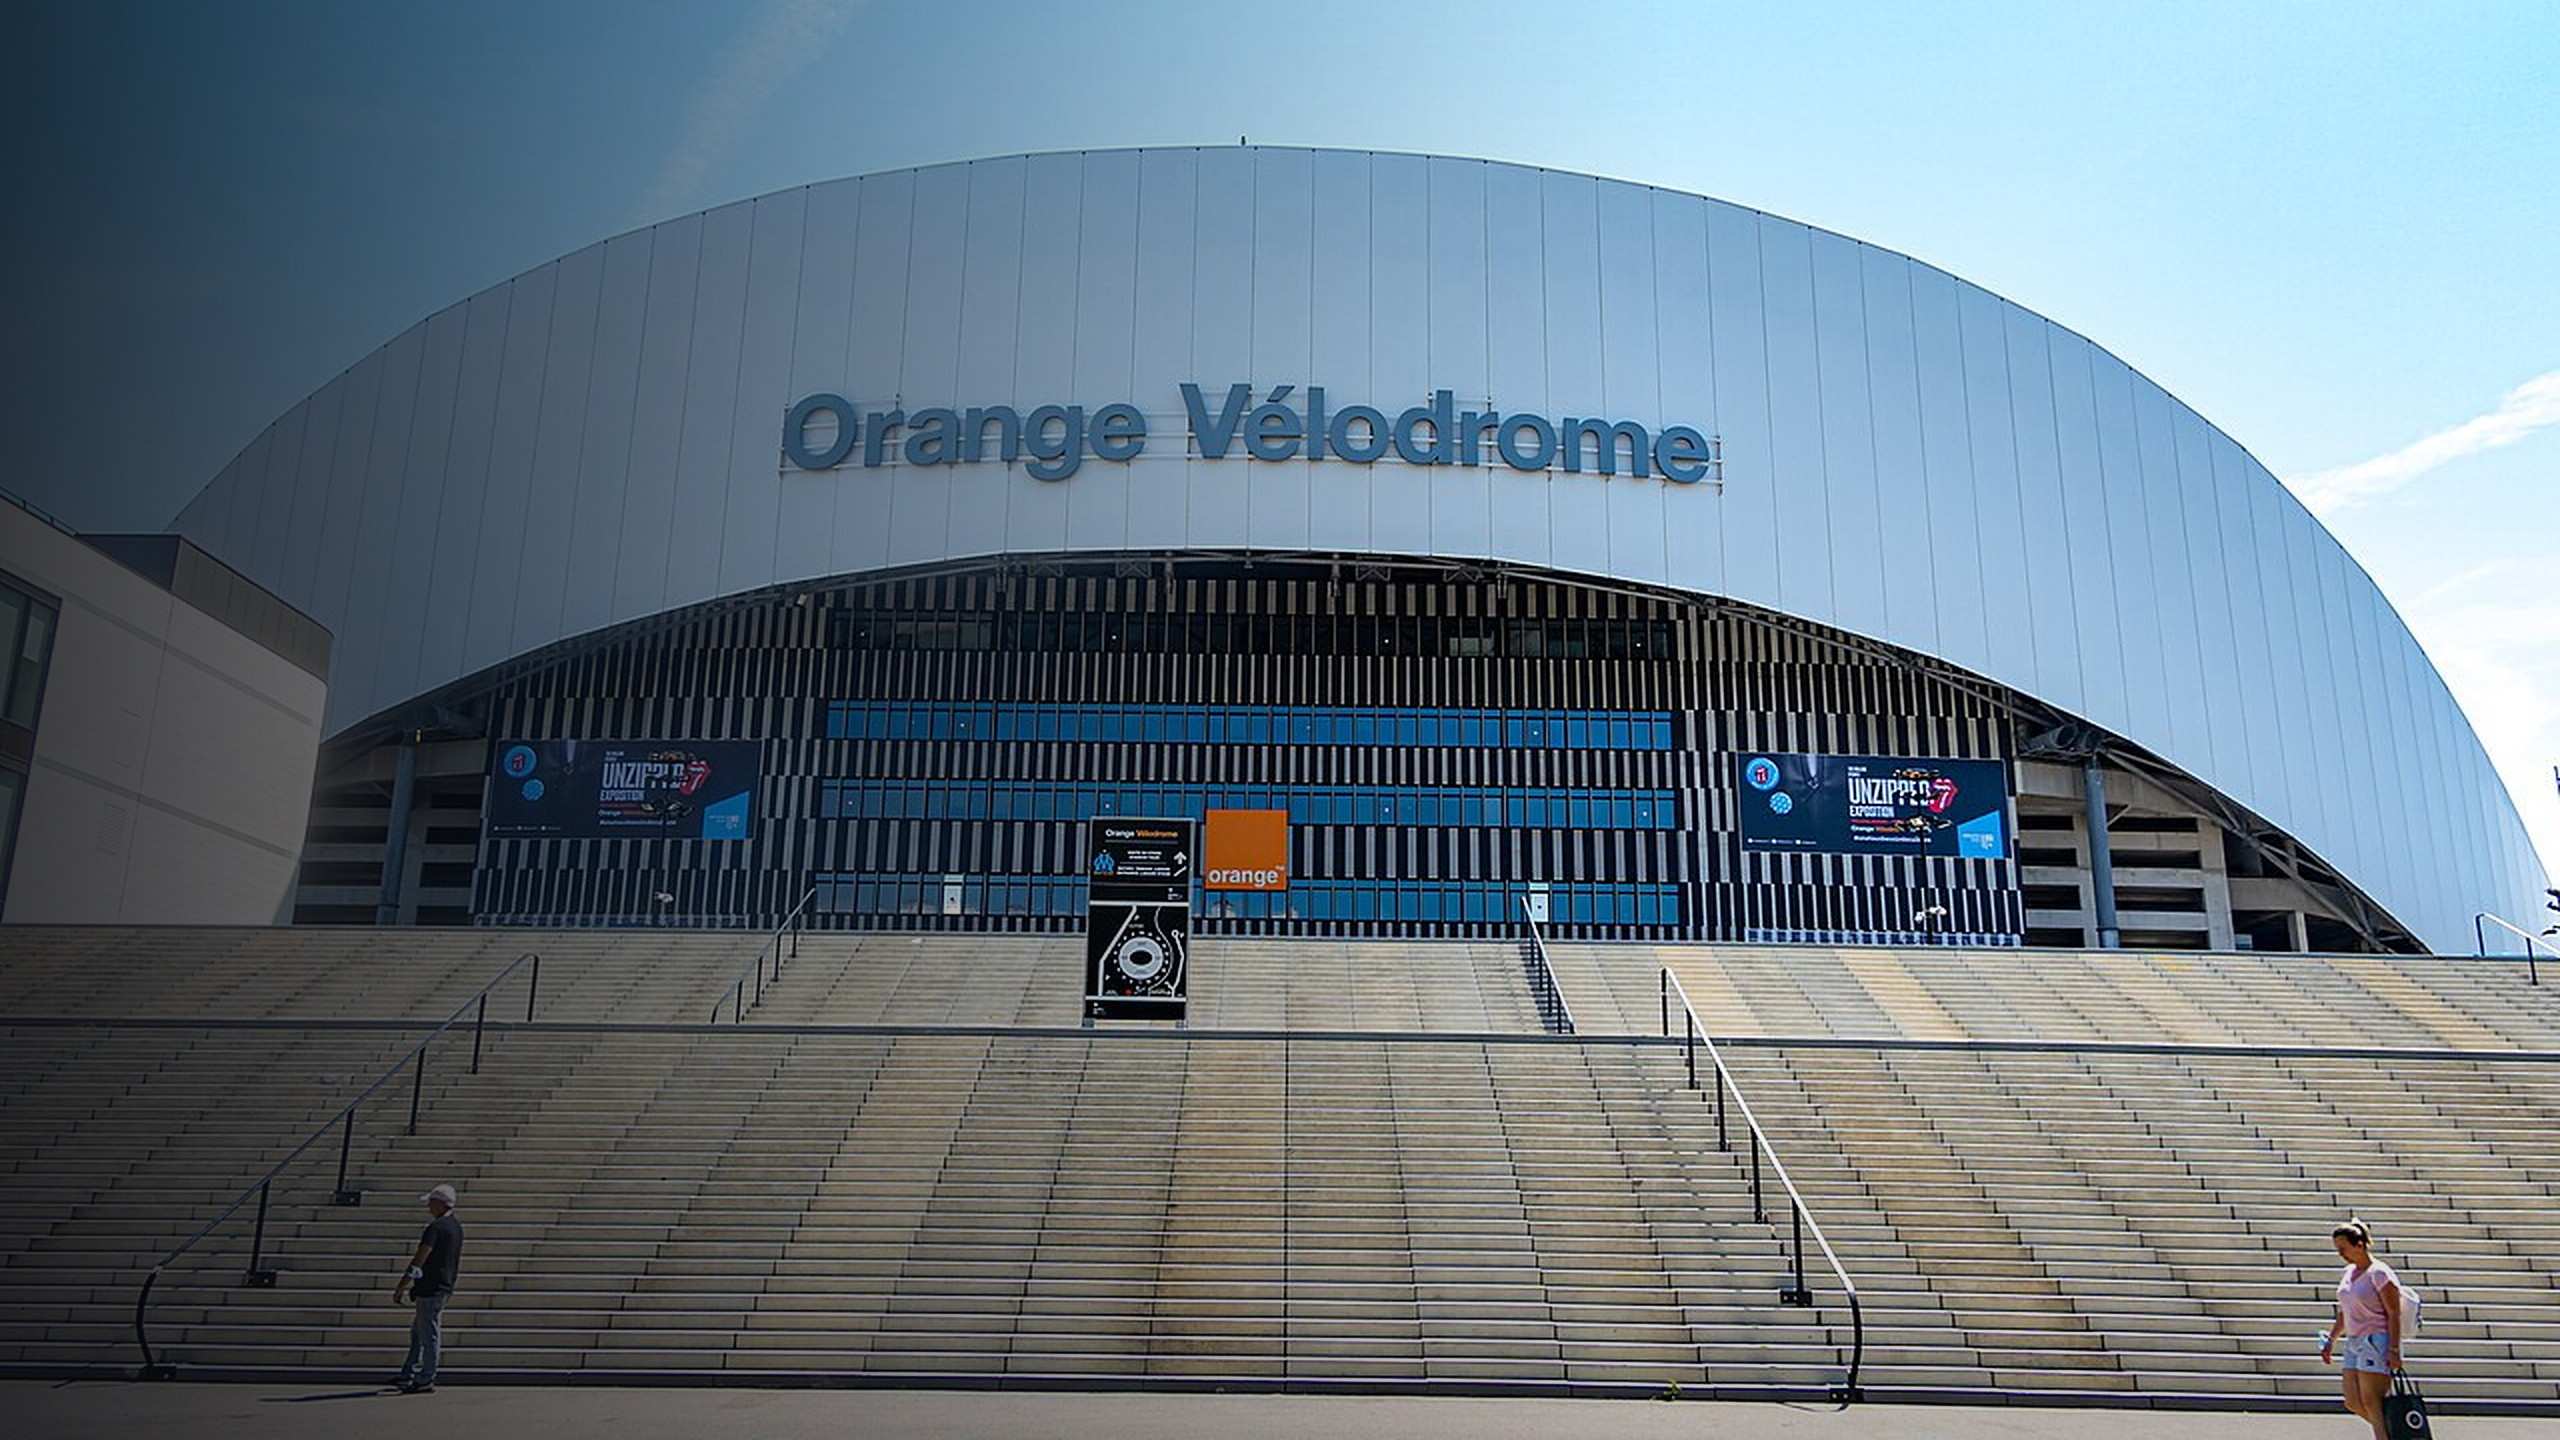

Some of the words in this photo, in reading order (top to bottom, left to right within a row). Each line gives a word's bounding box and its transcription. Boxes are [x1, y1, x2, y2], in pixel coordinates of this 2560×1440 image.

[783, 393, 1146, 482] Orange
[1180, 383, 1710, 484] Vélodrome
[1105, 829, 1135, 839] Orange
[1208, 869, 1279, 888] orange
